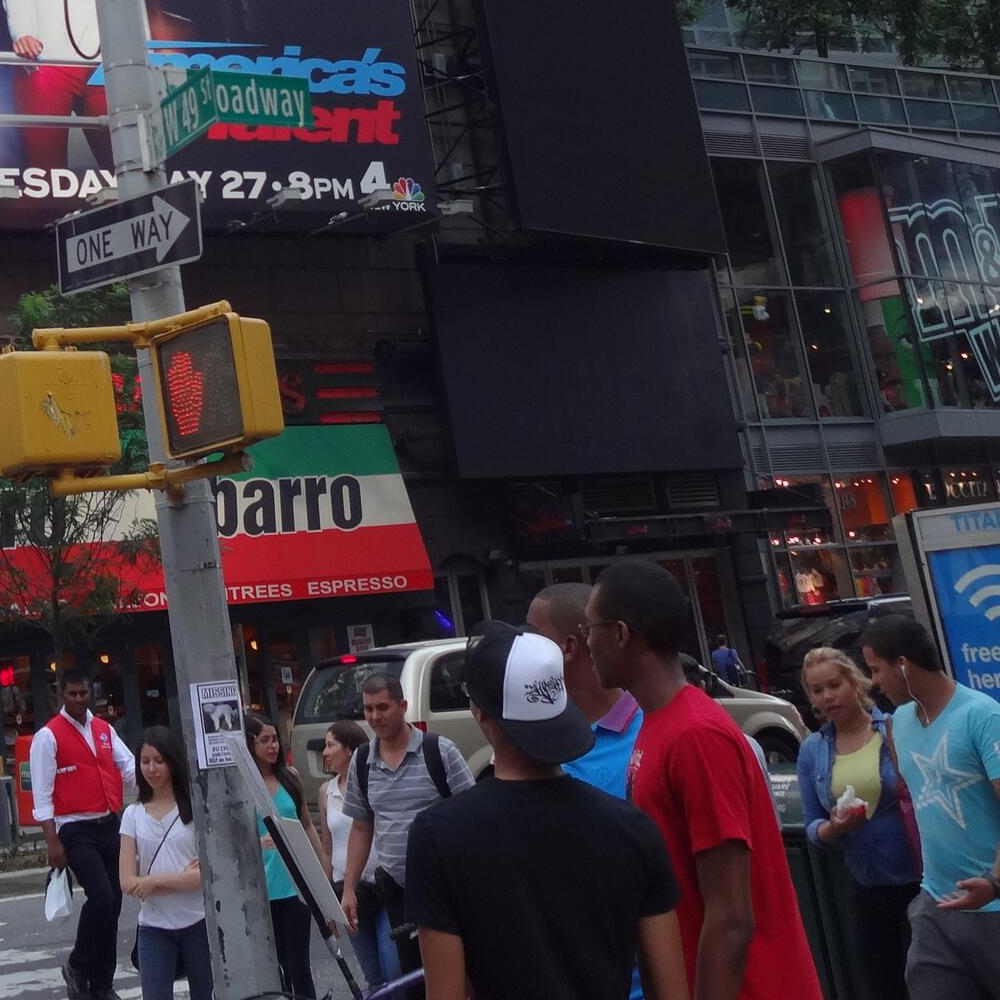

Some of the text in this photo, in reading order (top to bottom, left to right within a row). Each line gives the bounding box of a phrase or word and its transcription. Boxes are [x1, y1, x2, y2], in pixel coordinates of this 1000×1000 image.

[163, 101, 179, 146] W
[182, 87, 199, 133] 49
[216, 78, 305, 128] oadway
[392, 201, 426, 212] YORK
[76, 210, 173, 266] ONE WAY
[214, 474, 363, 538] barro
[951, 508, 1000, 532] TITA
[224, 583, 292, 601] TREES
[307, 575, 407, 596] ESPRESSO
[967, 669, 1000, 689] her
